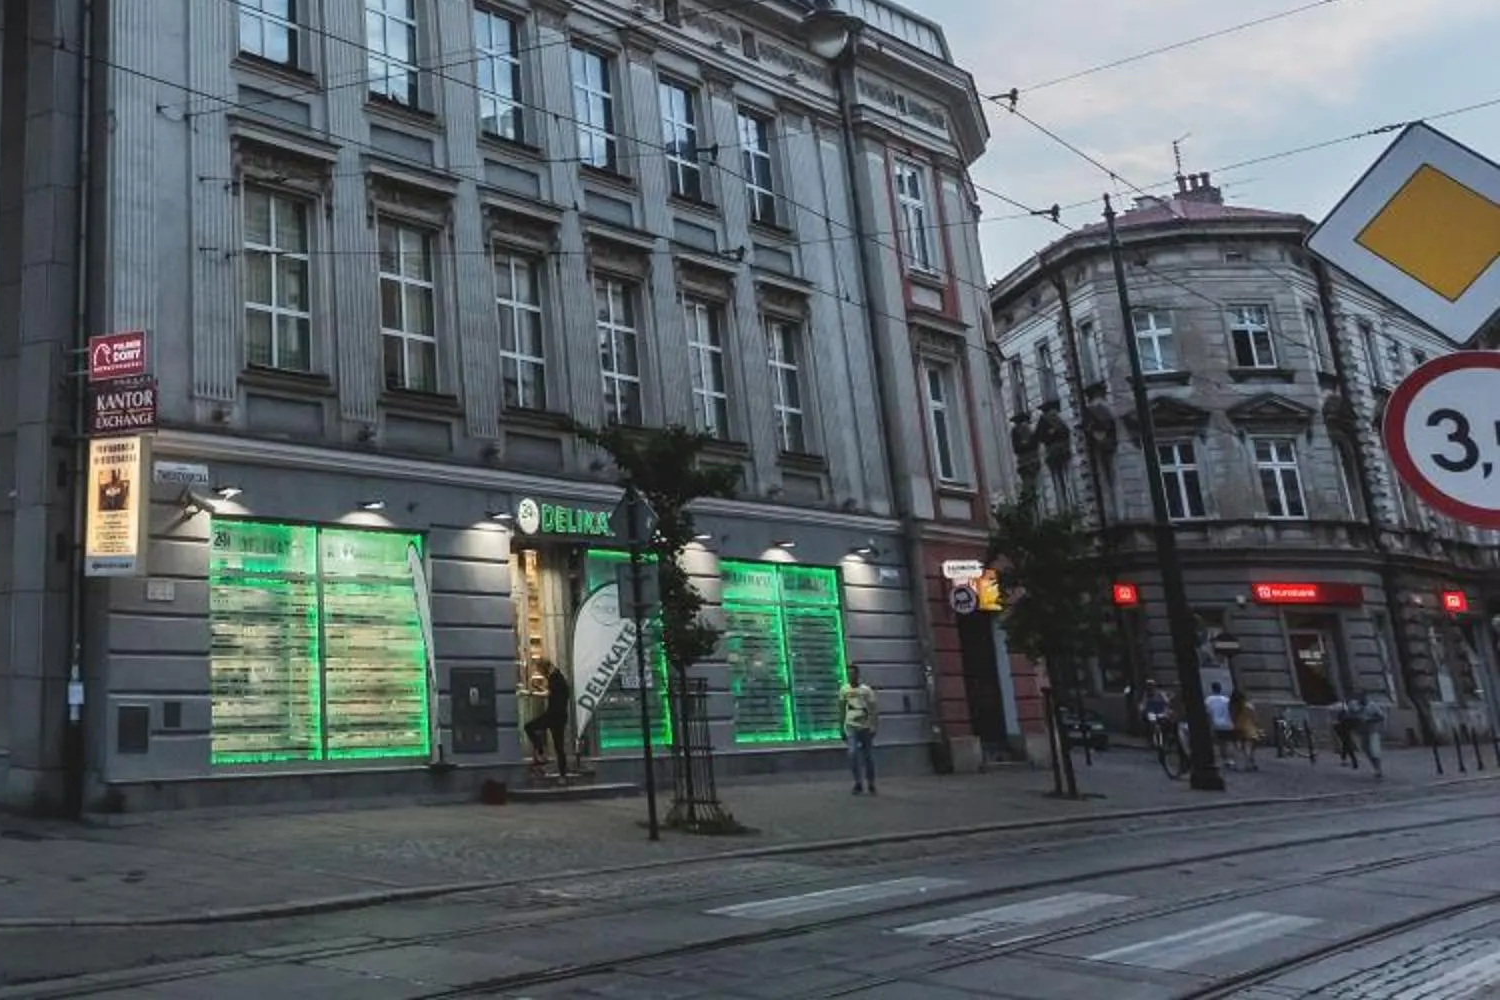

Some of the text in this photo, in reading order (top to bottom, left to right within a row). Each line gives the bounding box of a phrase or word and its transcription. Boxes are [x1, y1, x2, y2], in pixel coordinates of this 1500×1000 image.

[97, 390, 154, 411] KANTOR
[95, 411, 154, 429] EXCHANGE
[1426, 408, 1500, 479] 3,
[541, 503, 614, 536] DELIKA
